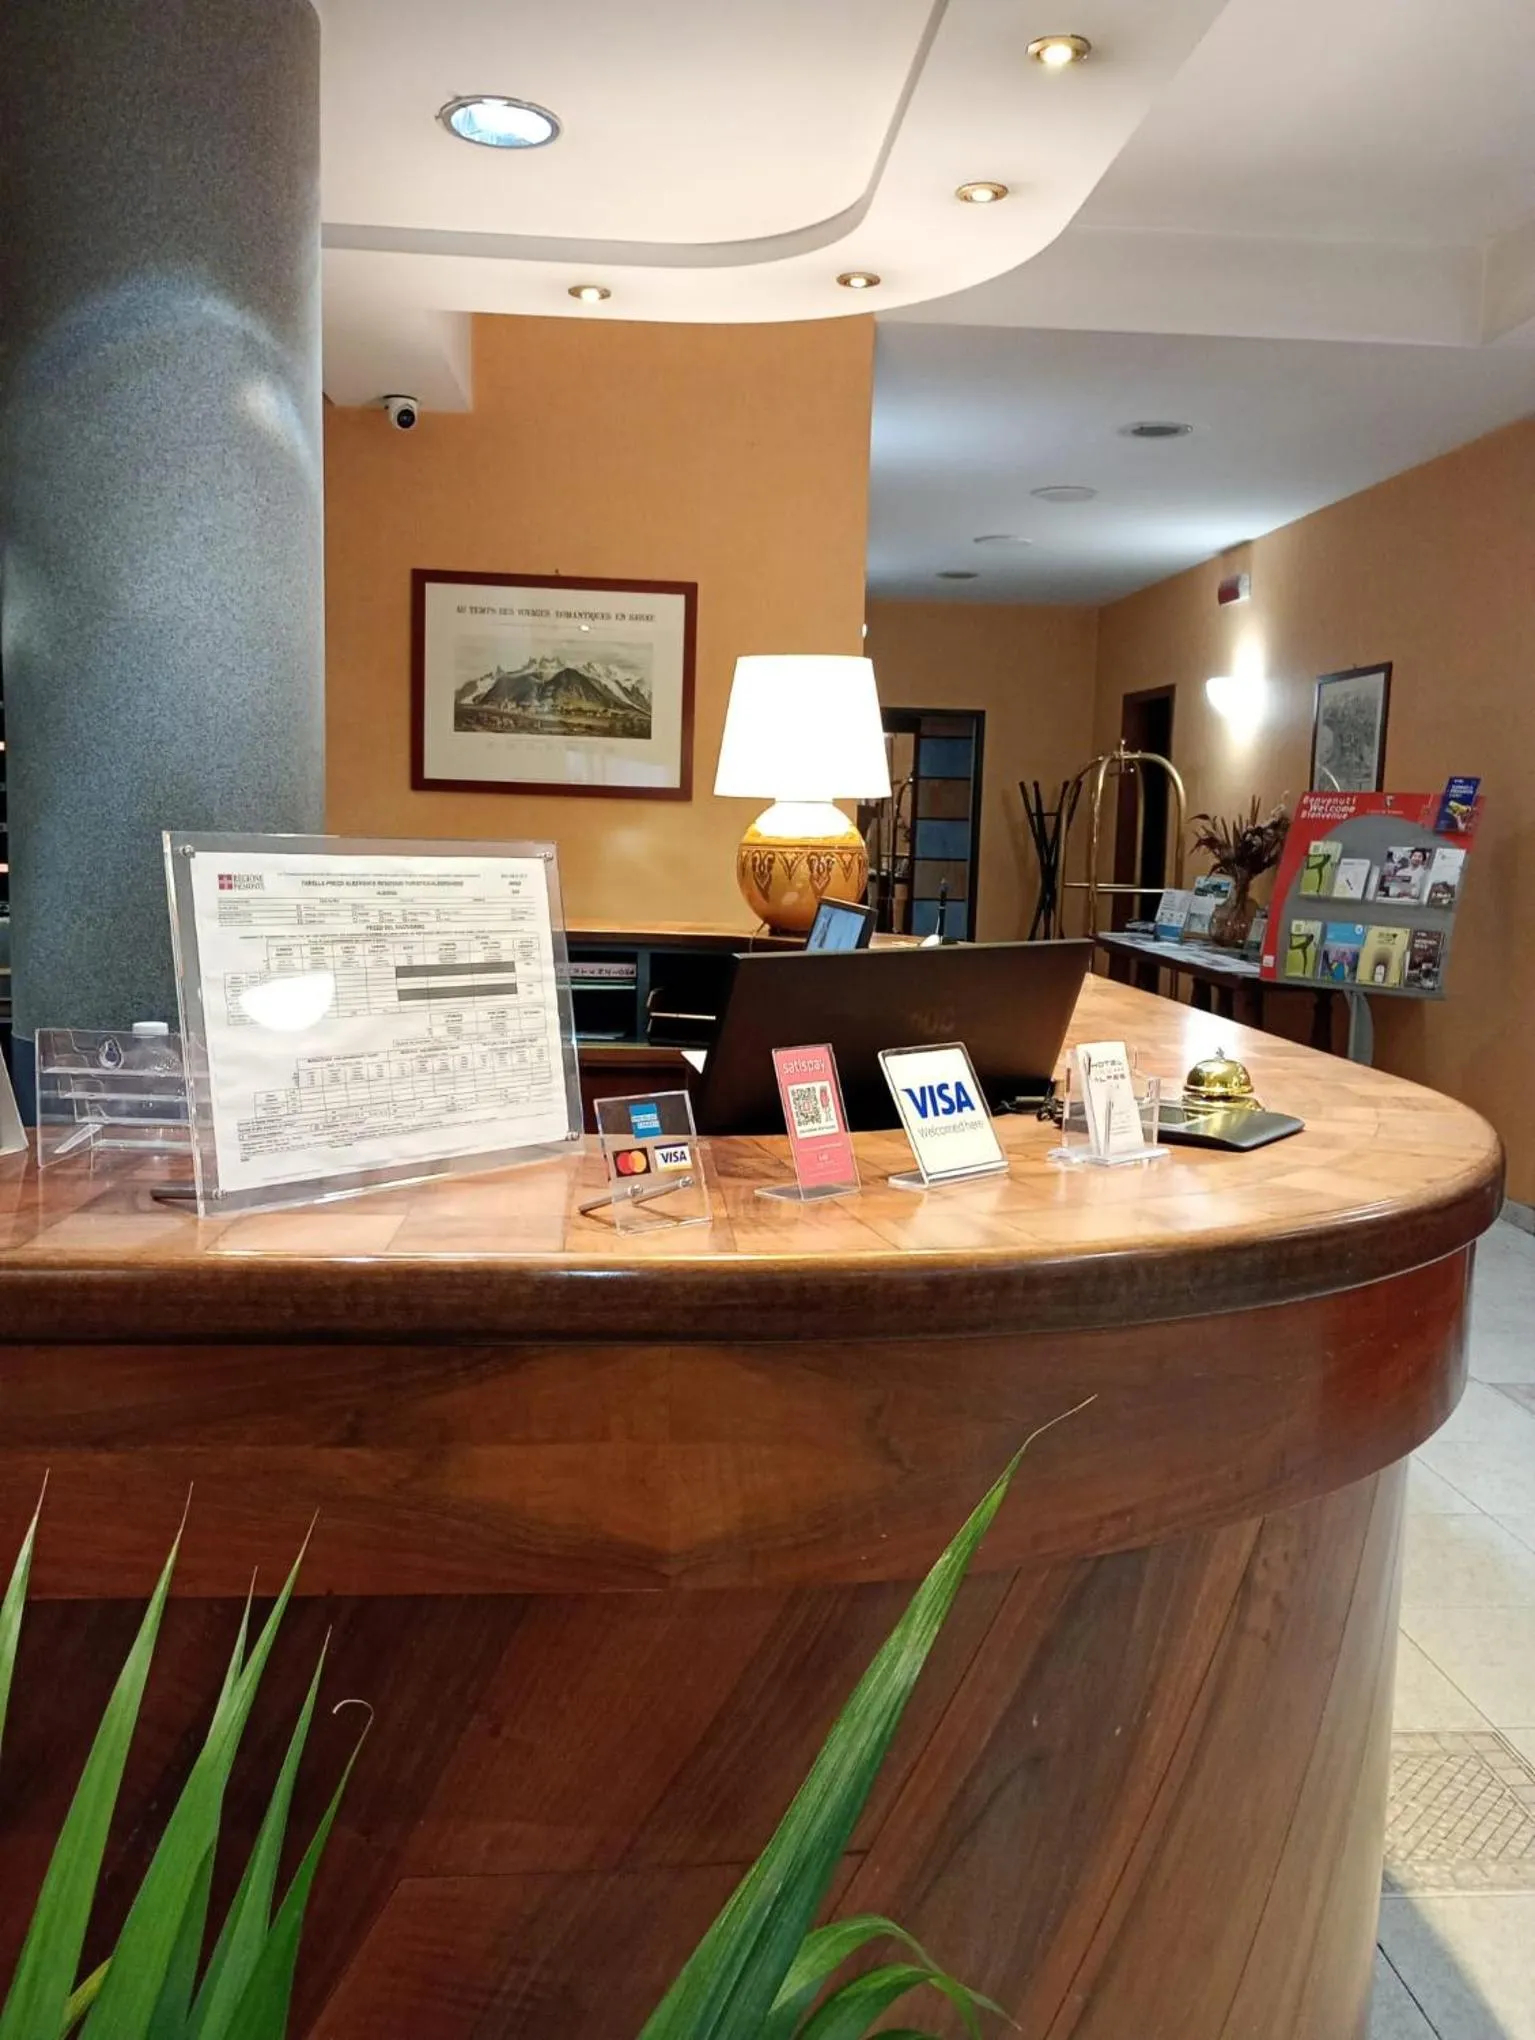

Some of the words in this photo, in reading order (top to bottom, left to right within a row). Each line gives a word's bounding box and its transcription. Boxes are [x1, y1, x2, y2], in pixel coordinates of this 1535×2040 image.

[783, 1059, 825, 1075] satispay
[900, 1081, 975, 1119] VISA
[660, 1151, 688, 1163] VISA
